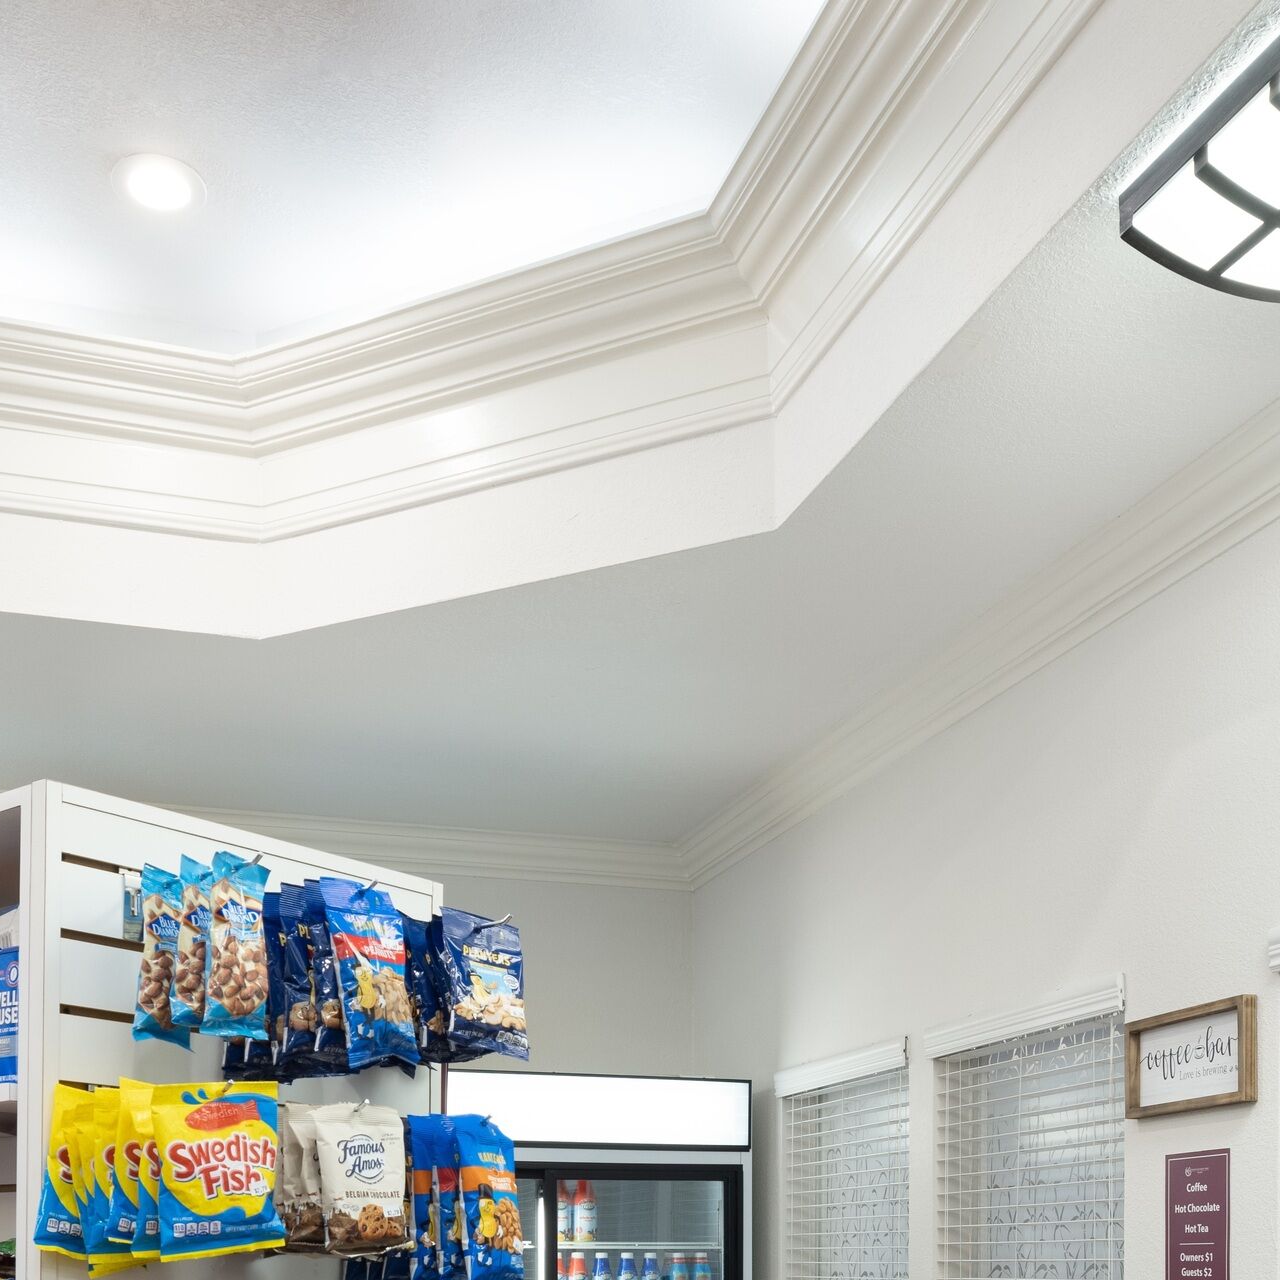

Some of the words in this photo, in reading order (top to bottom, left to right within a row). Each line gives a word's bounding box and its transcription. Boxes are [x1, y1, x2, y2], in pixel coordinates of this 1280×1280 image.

[152, 922, 179, 938] DIAMO
[160, 916, 175, 930] BLUE
[1140, 1044, 1194, 1080] coffee
[1205, 1026, 1239, 1062] bar
[1180, 1070, 1194, 1080] Love
[1195, 1069, 1202, 1078] is
[1202, 1064, 1228, 1077] brewing
[167, 1132, 278, 1181] Swedish
[337, 1138, 385, 1165] Famous
[345, 1155, 382, 1178] Amos
[199, 1162, 266, 1199] Fish
[1186, 1183, 1208, 1192] Coffee
[345, 1190, 369, 1199] BELGIAN
[369, 1190, 401, 1199] CHOCOLATE
[1174, 1204, 1187, 1213] Hot
[1187, 1203, 1220, 1213] Chocolate
[1184, 1224, 1197, 1233] Hot
[1197, 1224, 1209, 1233] Tea
[1180, 1252, 1204, 1262] Owners
[1205, 1252, 1213, 1262] $1
[1181, 1268, 1203, 1277] Guests
[1204, 1268, 1213, 1277] $2
